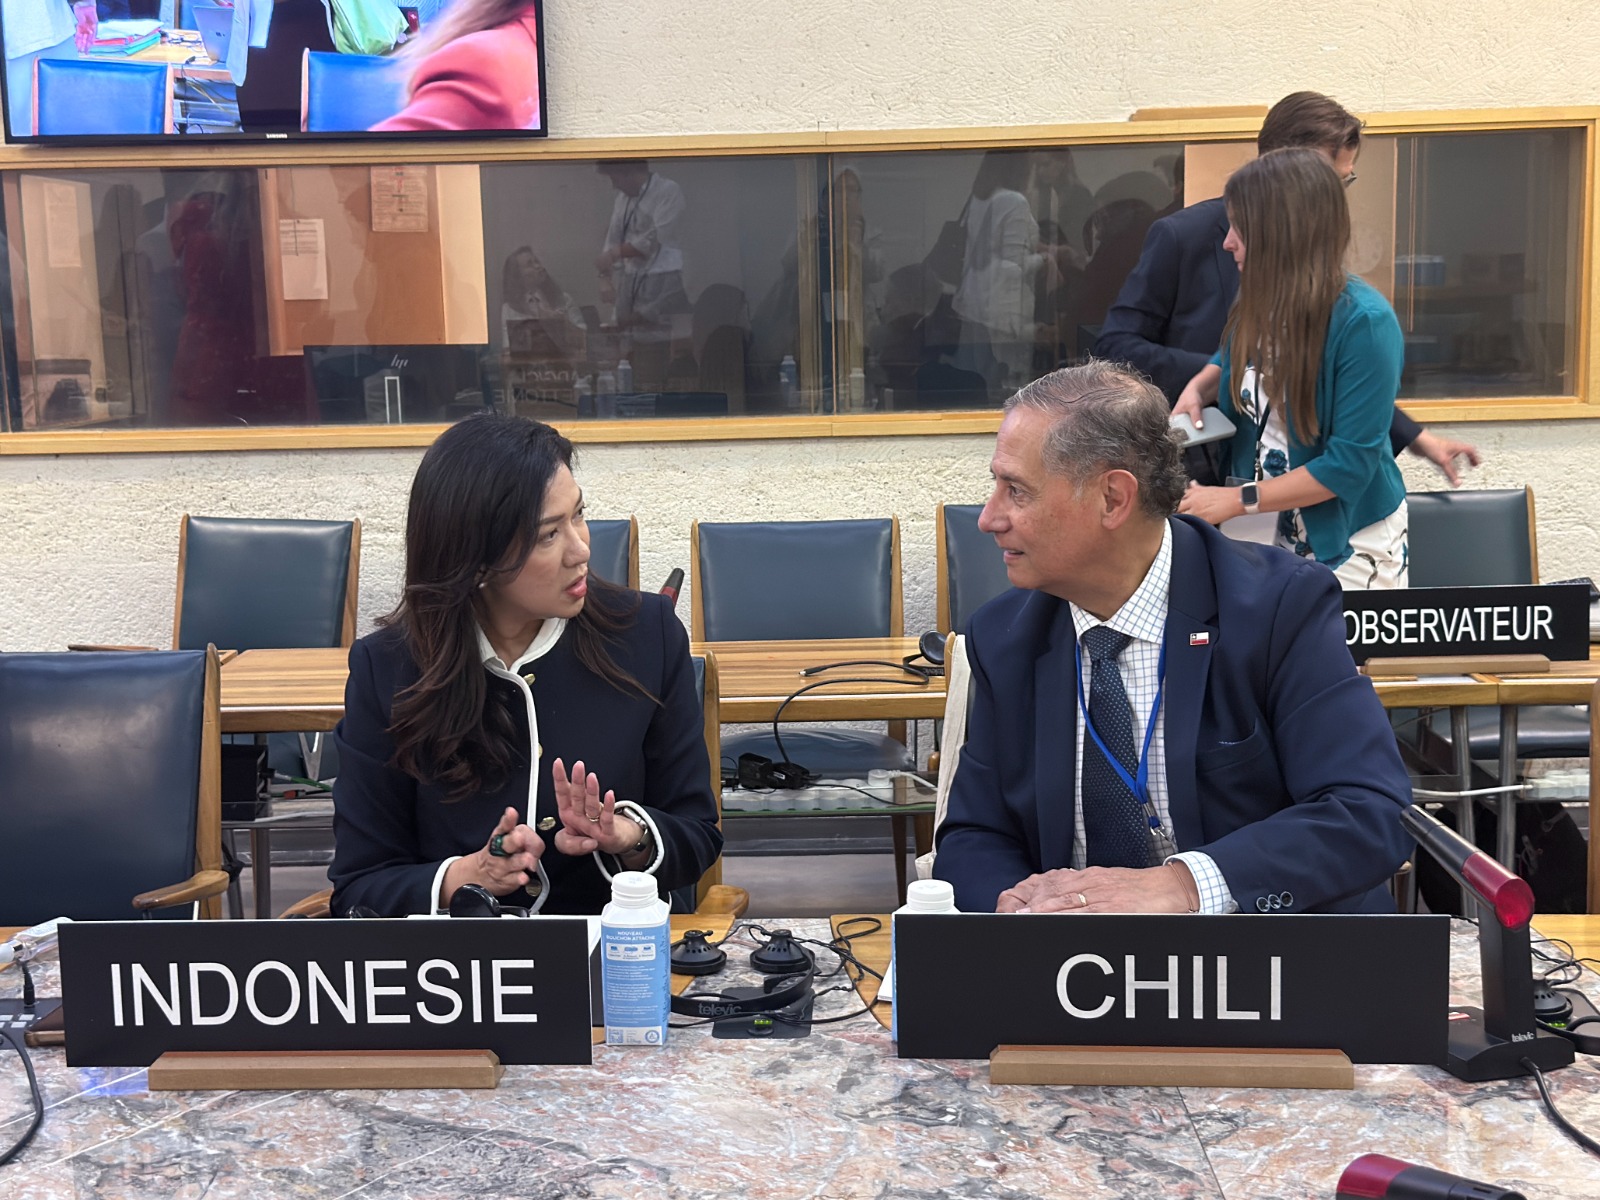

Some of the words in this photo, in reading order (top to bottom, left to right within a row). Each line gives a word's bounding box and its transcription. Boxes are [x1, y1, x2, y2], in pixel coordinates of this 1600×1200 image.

[390, 353, 408, 369] hp
[1343, 605, 1554, 645] OBSERVATEUR
[108, 957, 539, 1028] INDONESIE
[1055, 952, 1283, 1022] CHILI
[698, 1003, 742, 1016] televic
[1511, 1031, 1535, 1043] televic
